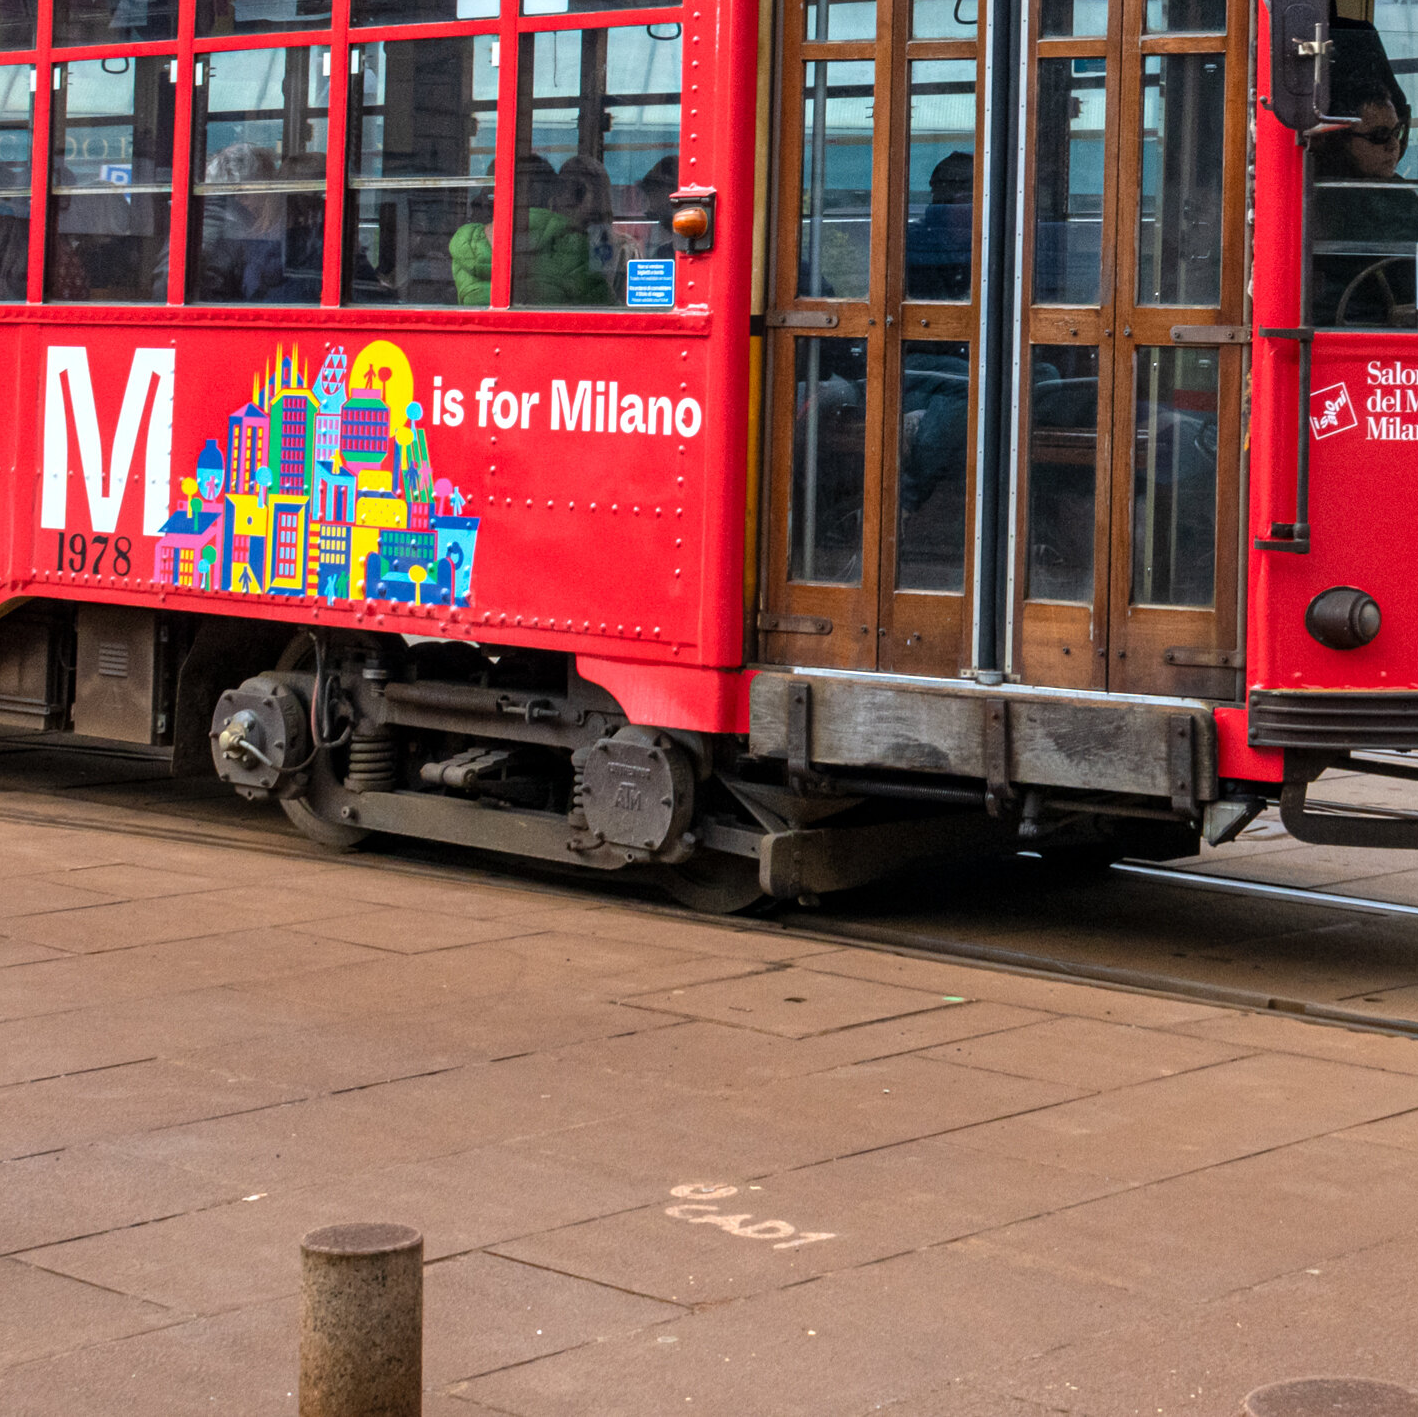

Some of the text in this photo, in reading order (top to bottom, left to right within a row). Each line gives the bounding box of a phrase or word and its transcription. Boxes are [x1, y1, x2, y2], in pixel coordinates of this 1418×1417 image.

[432, 375, 703, 438] is for Milano
[1366, 389, 1401, 414] del
[40, 345, 177, 538] M
[56, 532, 132, 577] 1978
